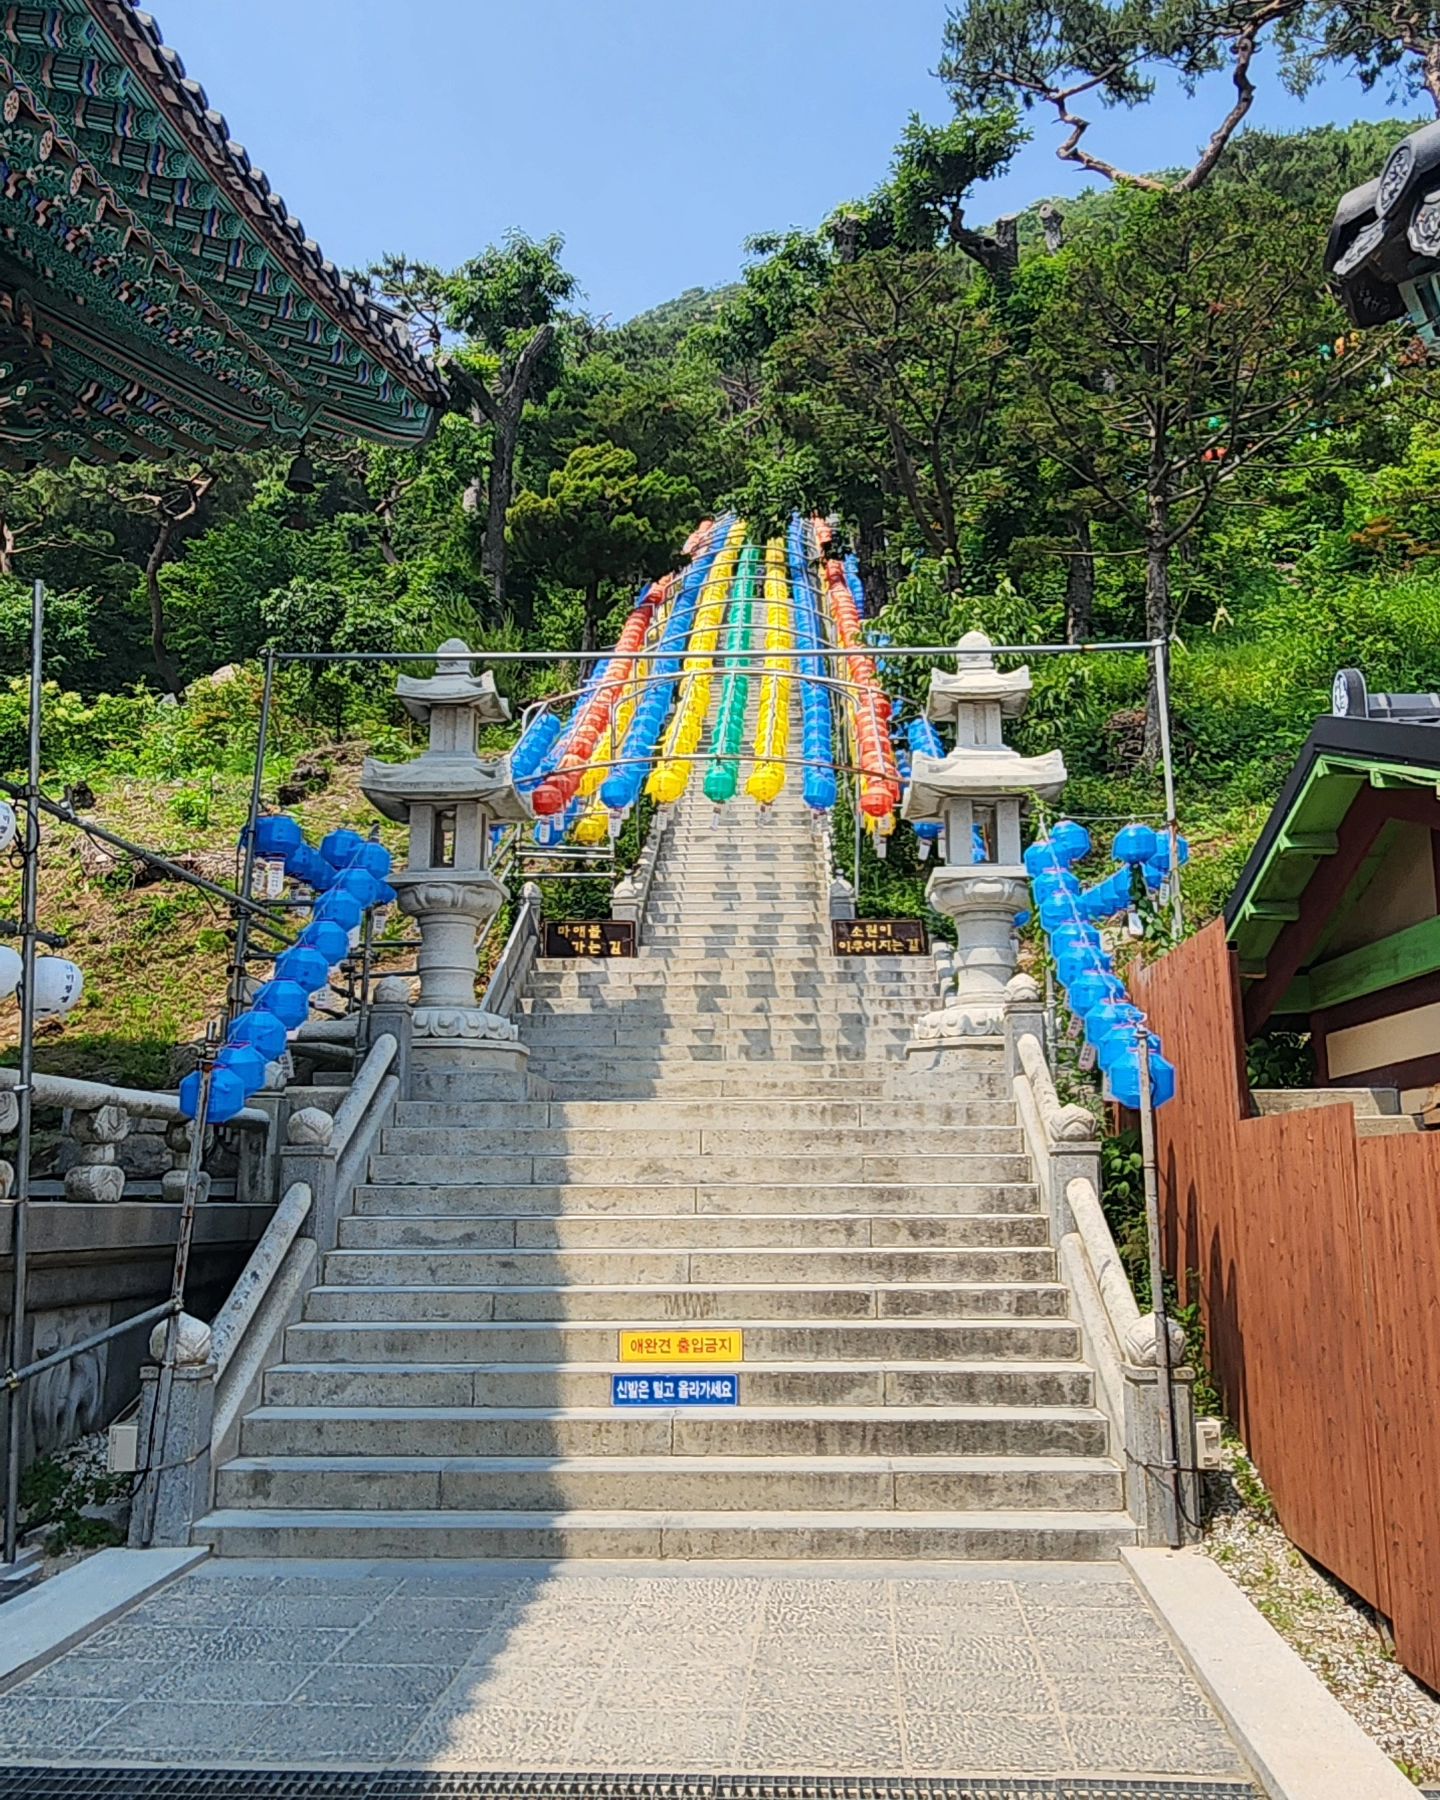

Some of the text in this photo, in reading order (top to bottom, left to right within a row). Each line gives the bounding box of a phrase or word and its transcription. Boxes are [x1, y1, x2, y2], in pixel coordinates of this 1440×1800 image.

[557, 924, 602, 939] 마애불
[571, 940, 622, 955] 가는 길
[905, 938, 920, 952] 길
[630, 1336, 732, 1354] 애완견 출입금지
[617, 1380, 732, 1399] 신발은 털고 올라가세요
